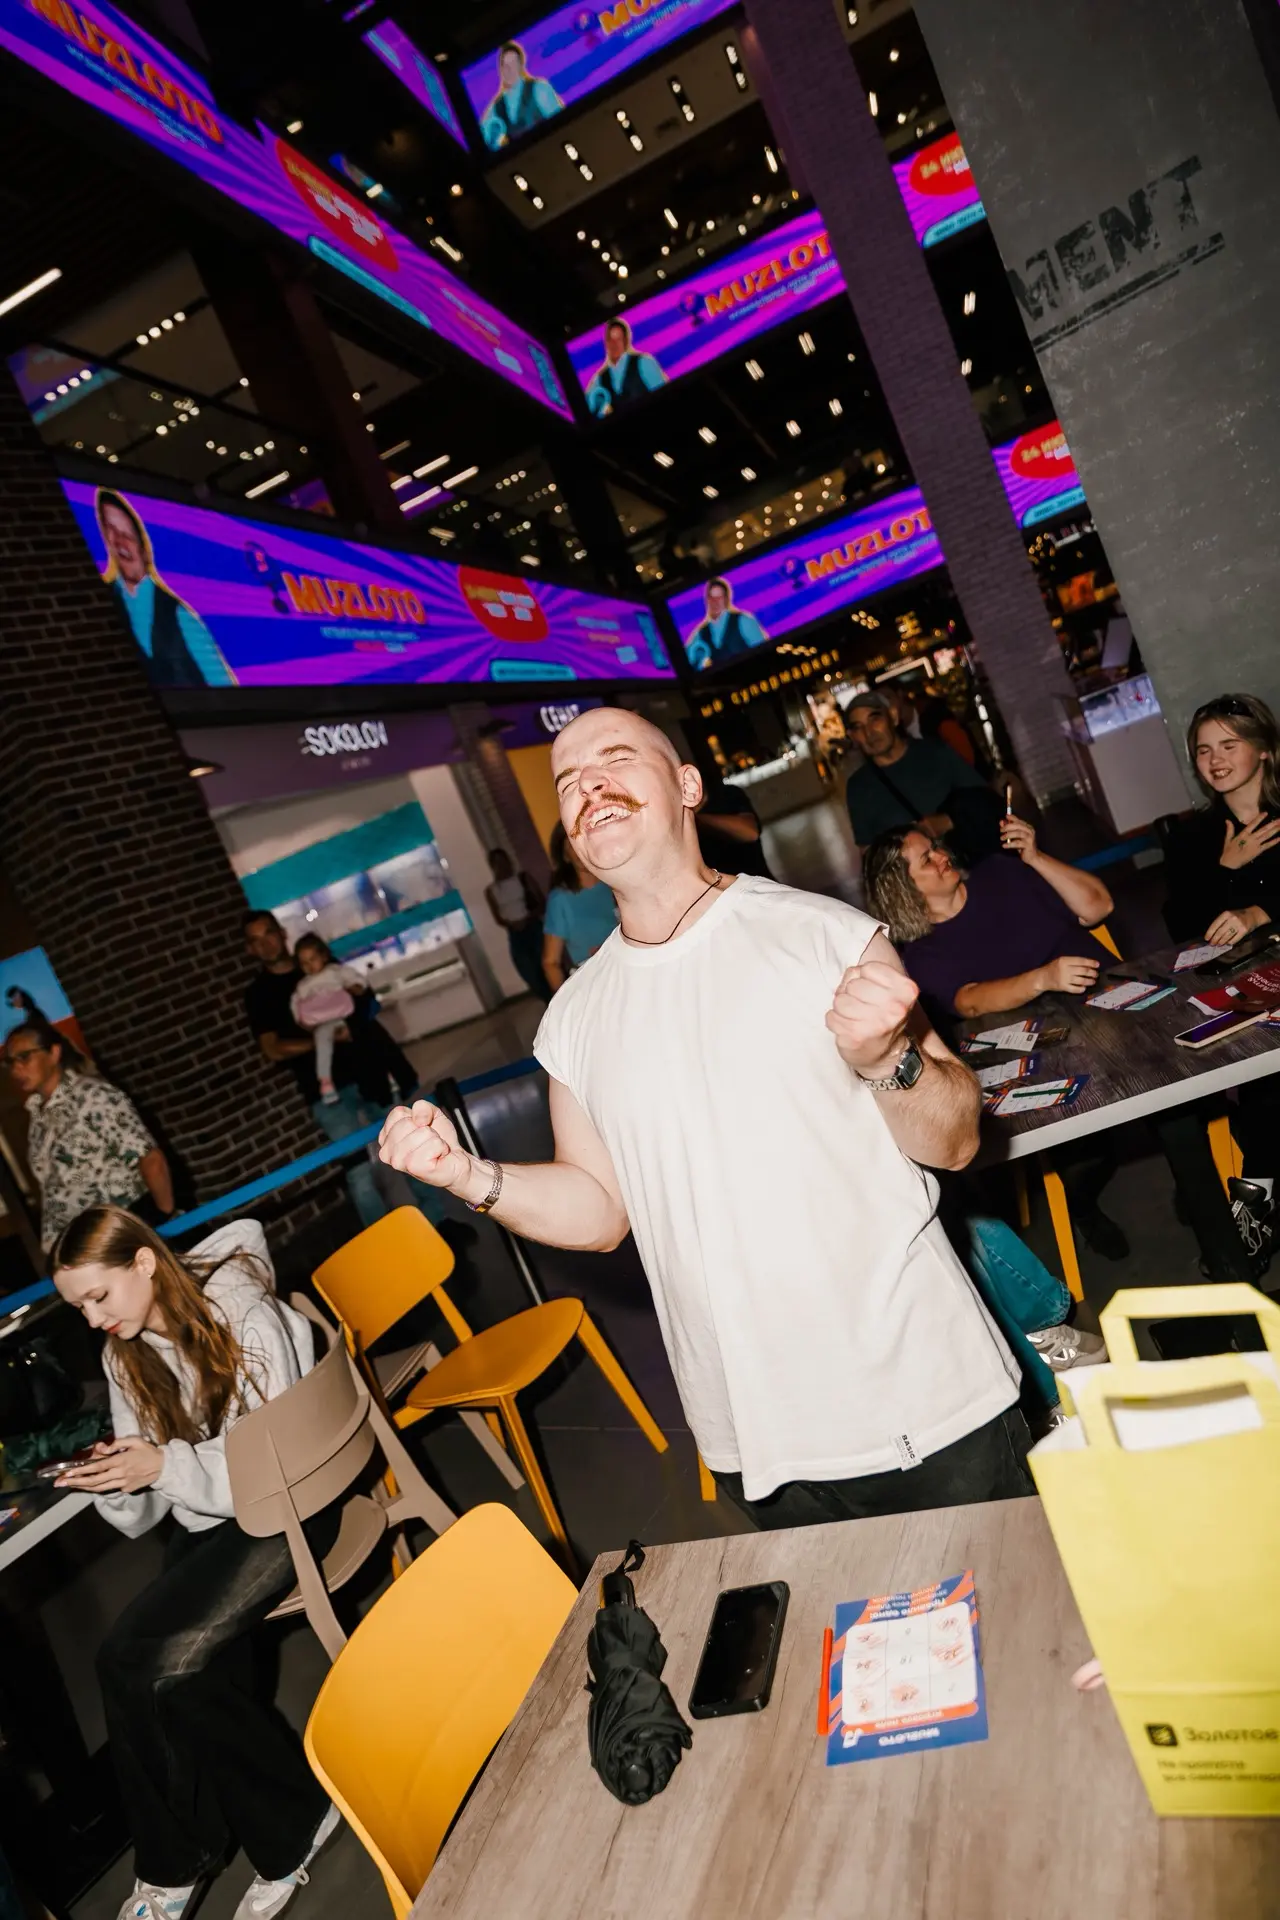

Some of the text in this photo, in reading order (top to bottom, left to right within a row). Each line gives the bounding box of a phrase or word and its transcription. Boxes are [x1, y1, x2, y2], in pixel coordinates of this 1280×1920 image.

[281, 572, 427, 625] MUZLOTO
[303, 720, 388, 756] SOKOLOV
[902, 1434, 916, 1459] BASIC
